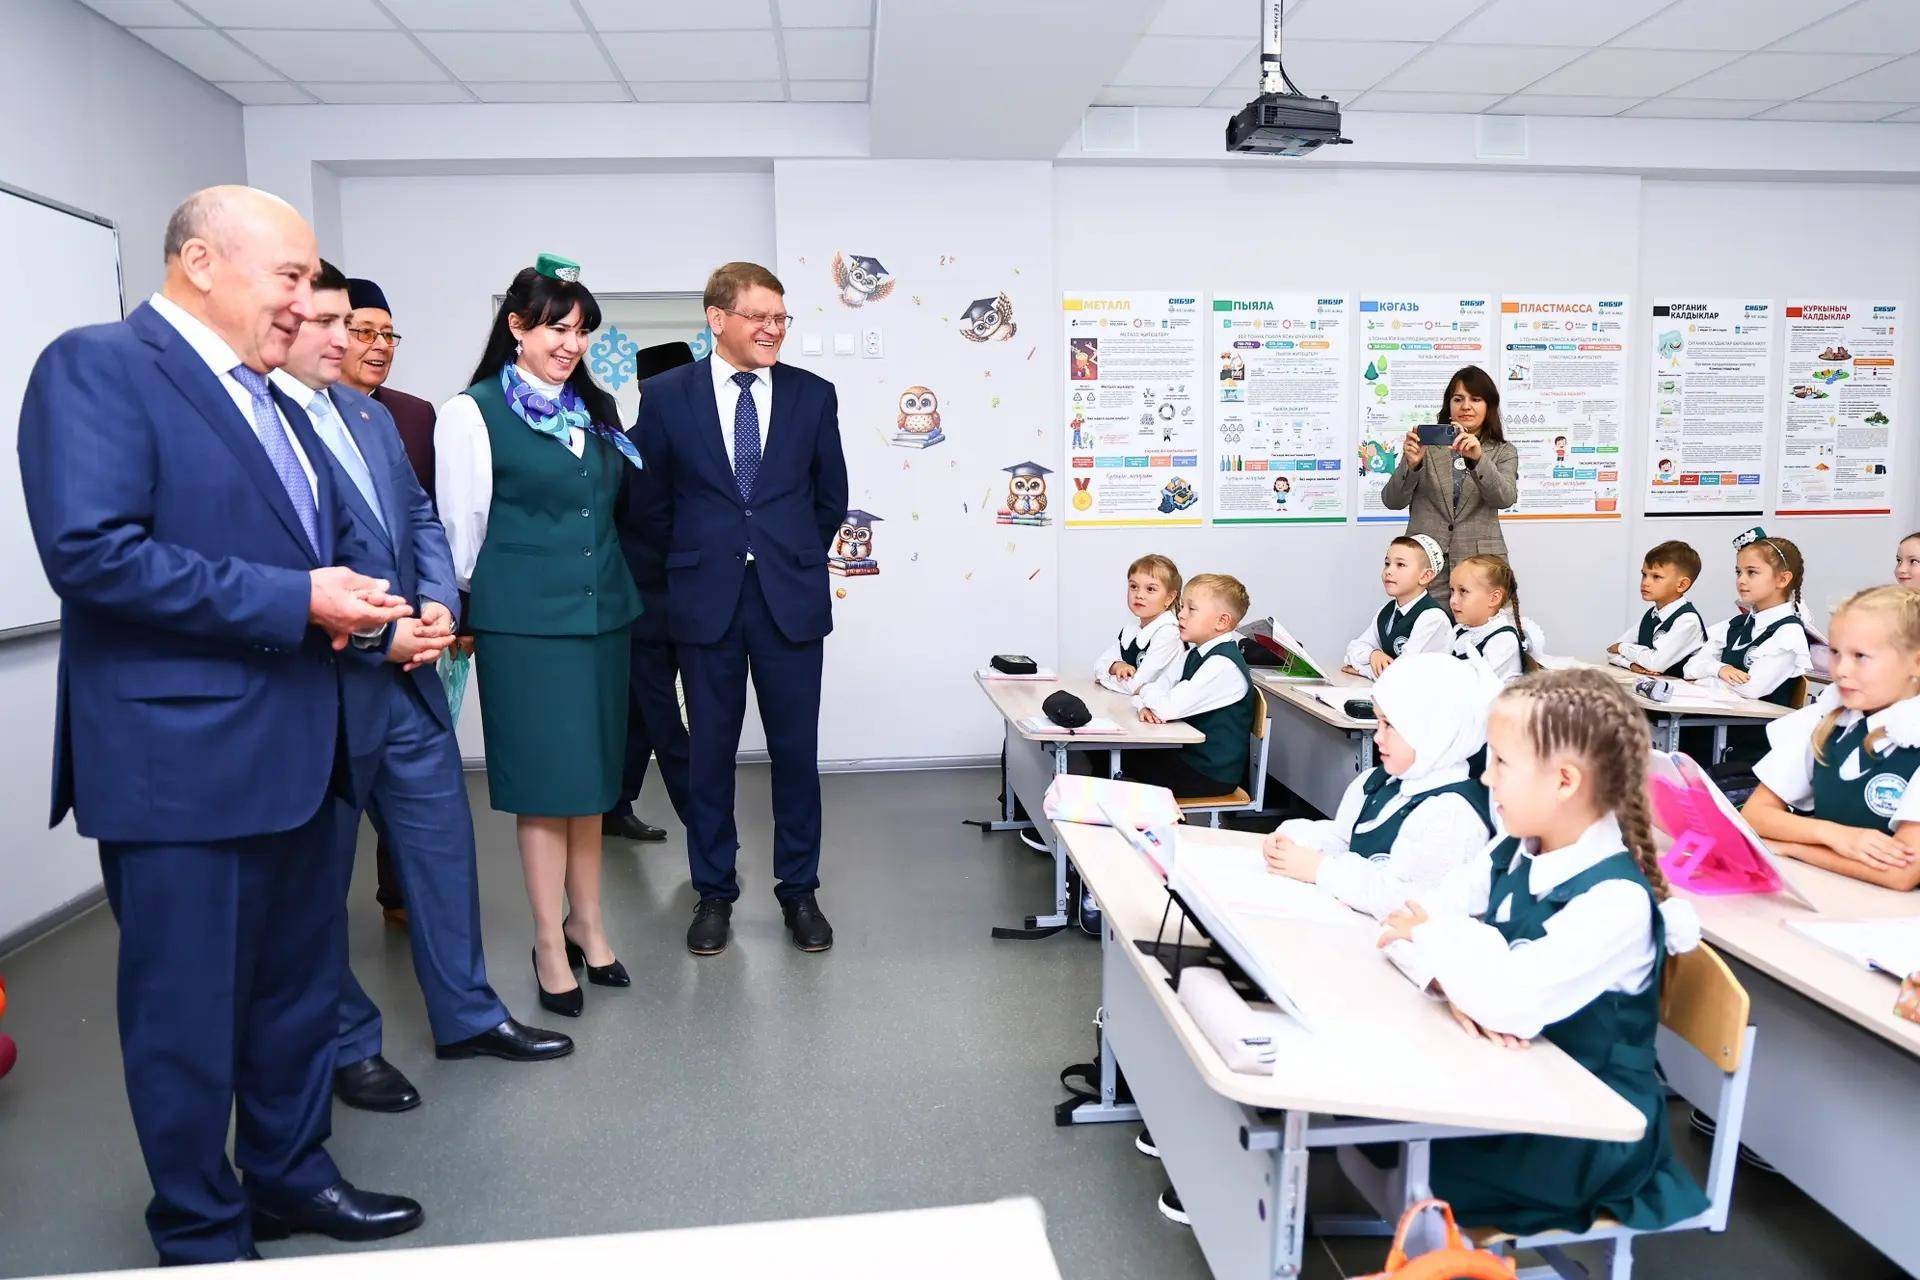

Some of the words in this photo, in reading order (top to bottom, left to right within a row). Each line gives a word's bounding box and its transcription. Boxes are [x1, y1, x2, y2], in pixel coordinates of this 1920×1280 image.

[1084, 300, 1131, 311] МЕТАЛЛ
[1233, 301, 1274, 311] ПЫЯЛА
[1379, 302, 1420, 312] КӘГАЗЬ
[1520, 303, 1593, 313] ПЛАСТМАССА
[1670, 312, 1720, 320] КАЛДЫКЛАР
[1802, 313, 1851, 321] КАЛДЫКЛАР
